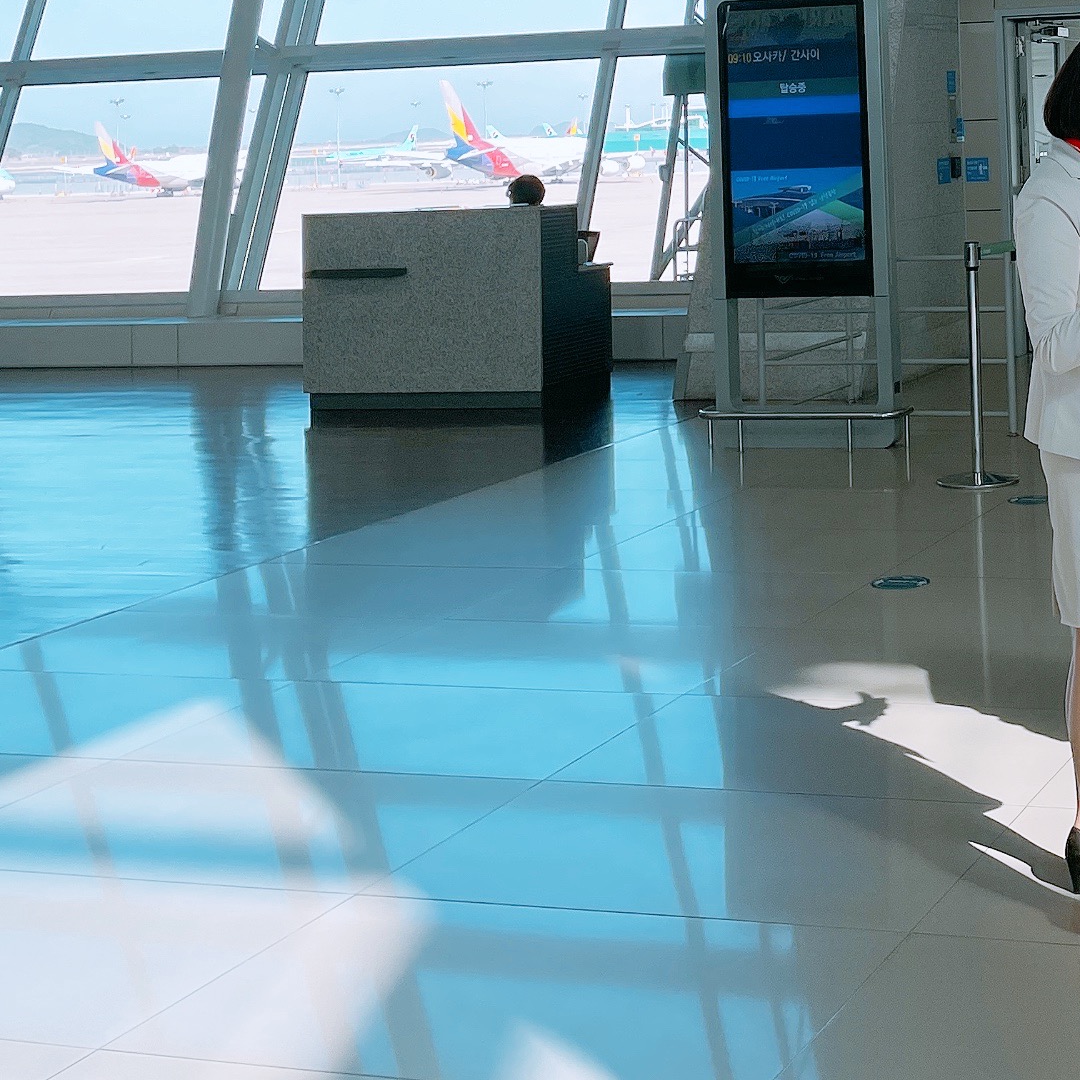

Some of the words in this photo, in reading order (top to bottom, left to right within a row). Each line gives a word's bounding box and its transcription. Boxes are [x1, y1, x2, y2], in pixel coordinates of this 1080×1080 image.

[728, 52, 752, 64] 09:10
[753, 51, 787, 63] 오사카/
[791, 48, 820, 61] 간사이
[779, 81, 807, 94] 탑승중
